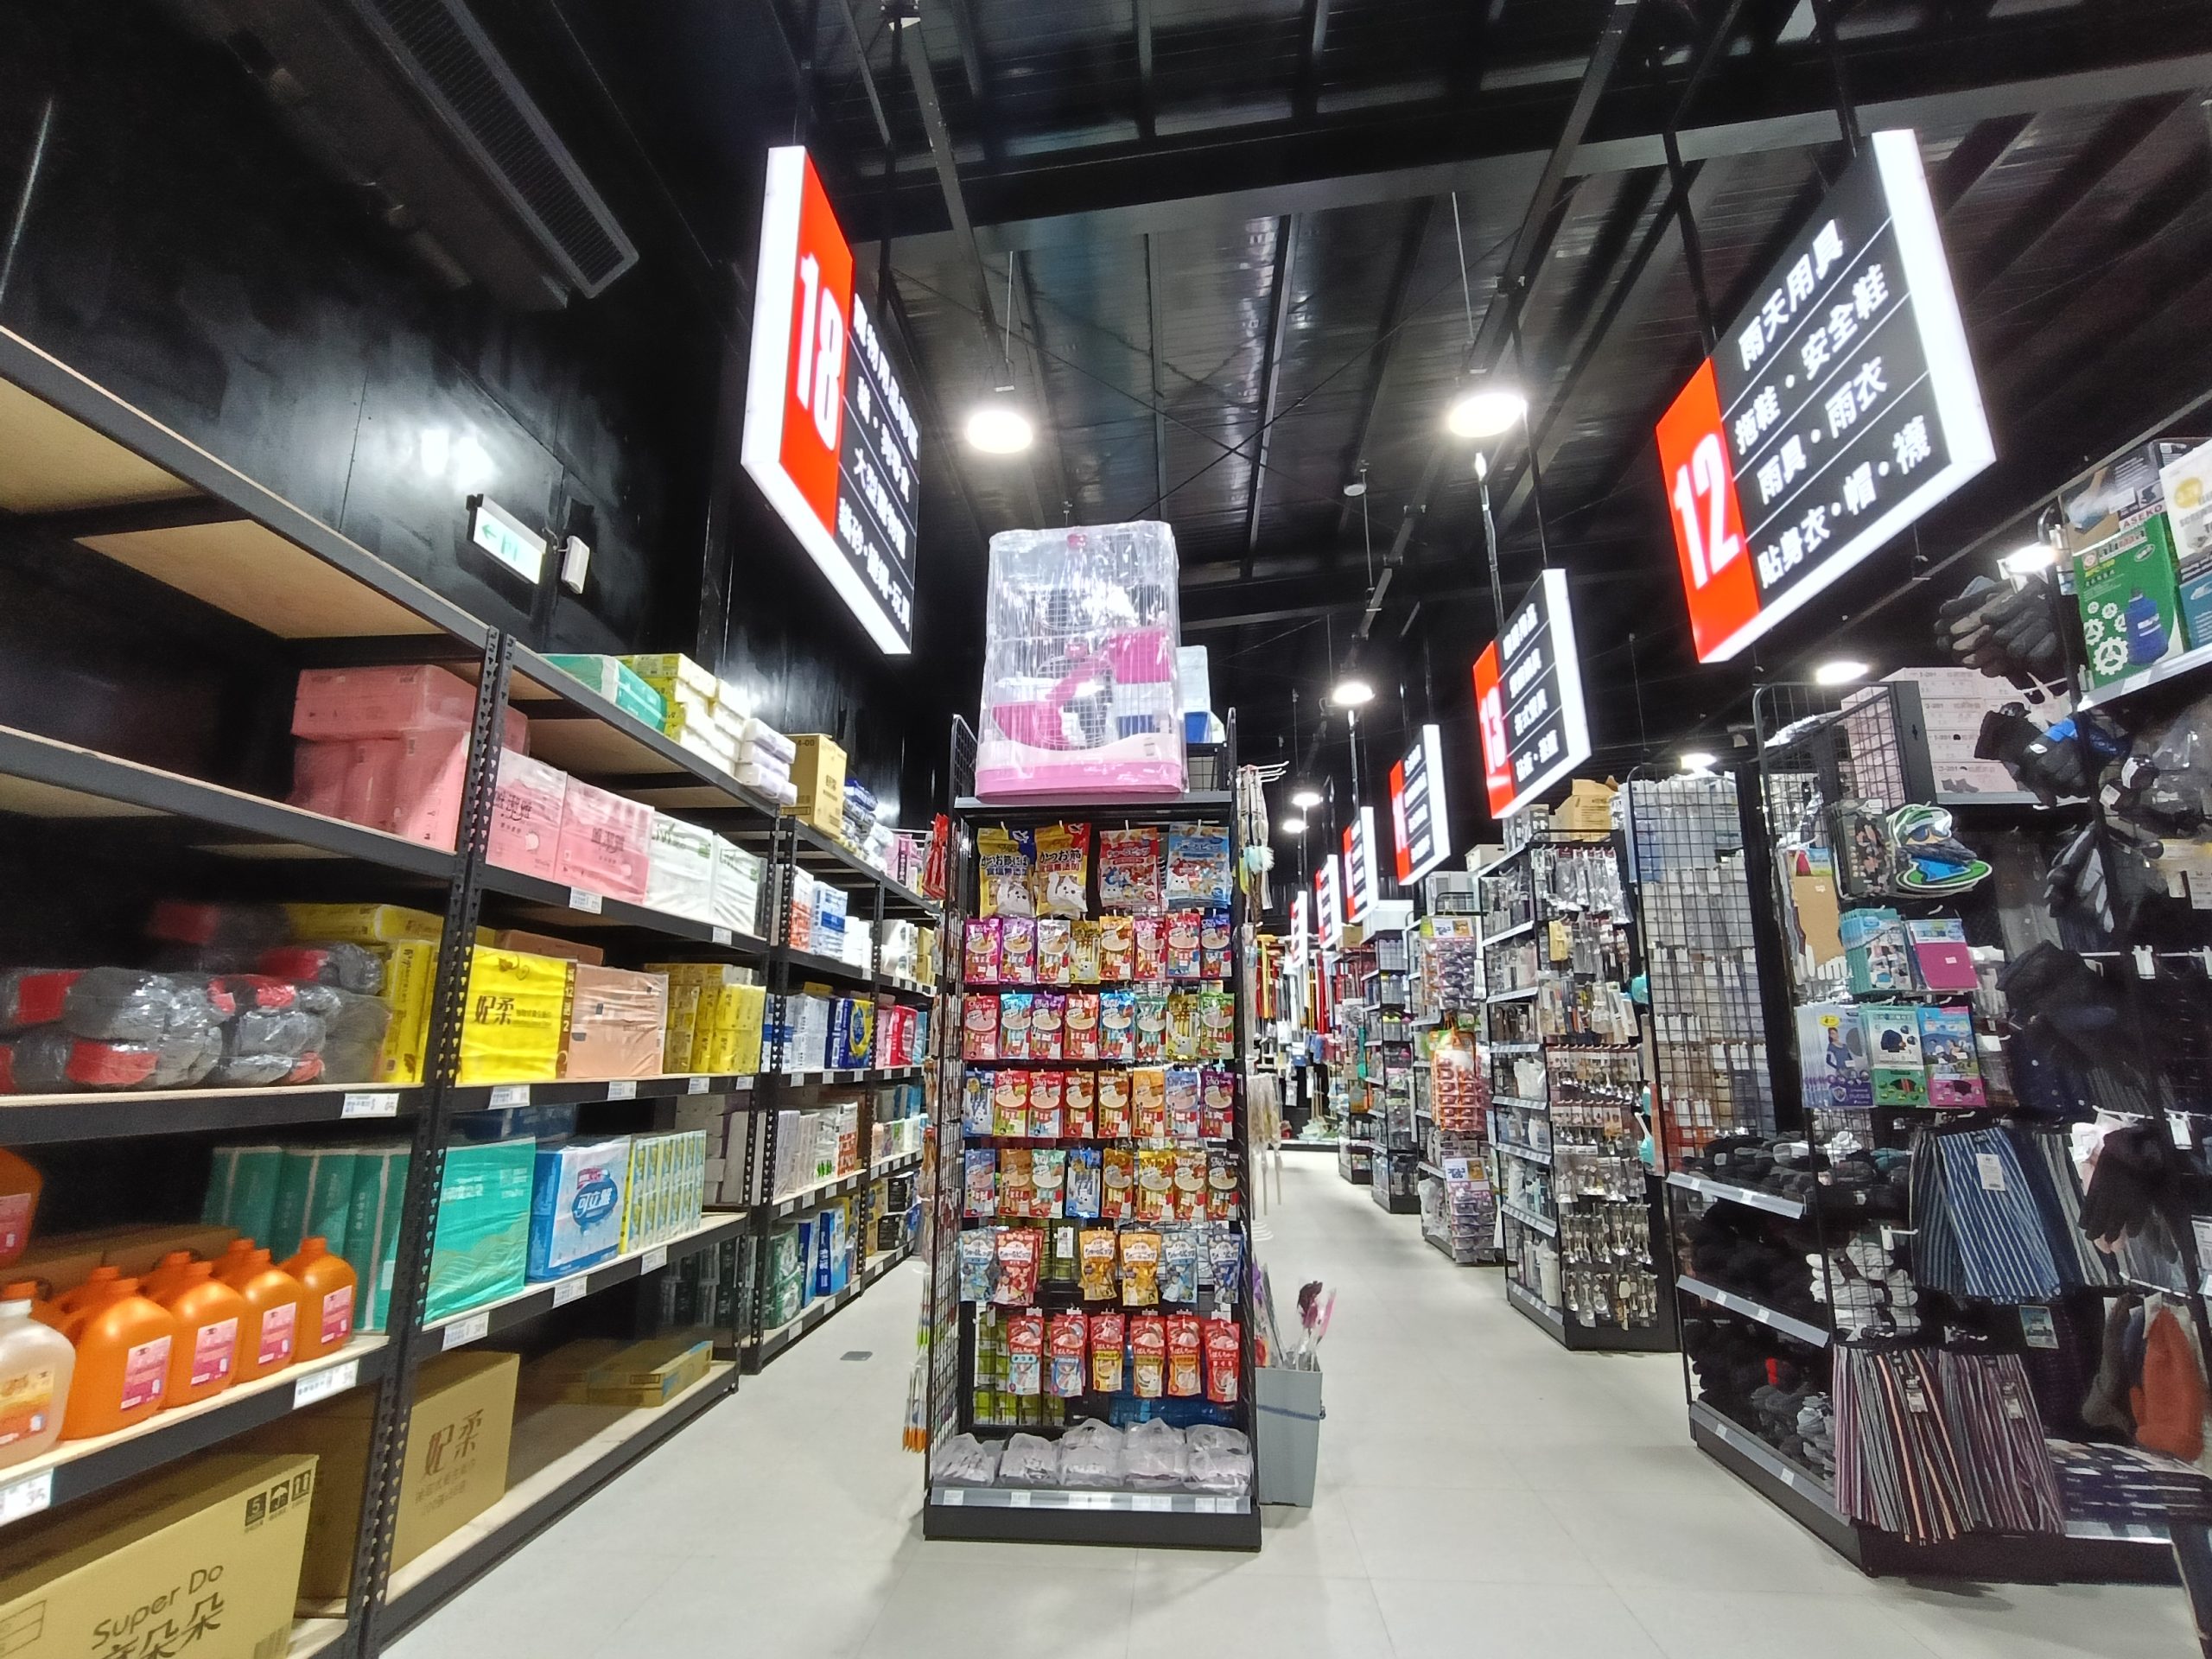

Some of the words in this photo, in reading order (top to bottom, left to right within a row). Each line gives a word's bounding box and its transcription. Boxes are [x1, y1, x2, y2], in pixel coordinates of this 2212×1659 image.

[1737, 218, 1846, 372] 雨天用具
[796, 252, 846, 453] 18
[1674, 431, 1741, 591] 12
[2123, 504, 2163, 529] ASEKO
[1479, 686, 1507, 774] 13
[92, 1586, 181, 1650] Super
[188, 1565, 225, 1595] Do
[102, 1592, 226, 1659] 朵朵
